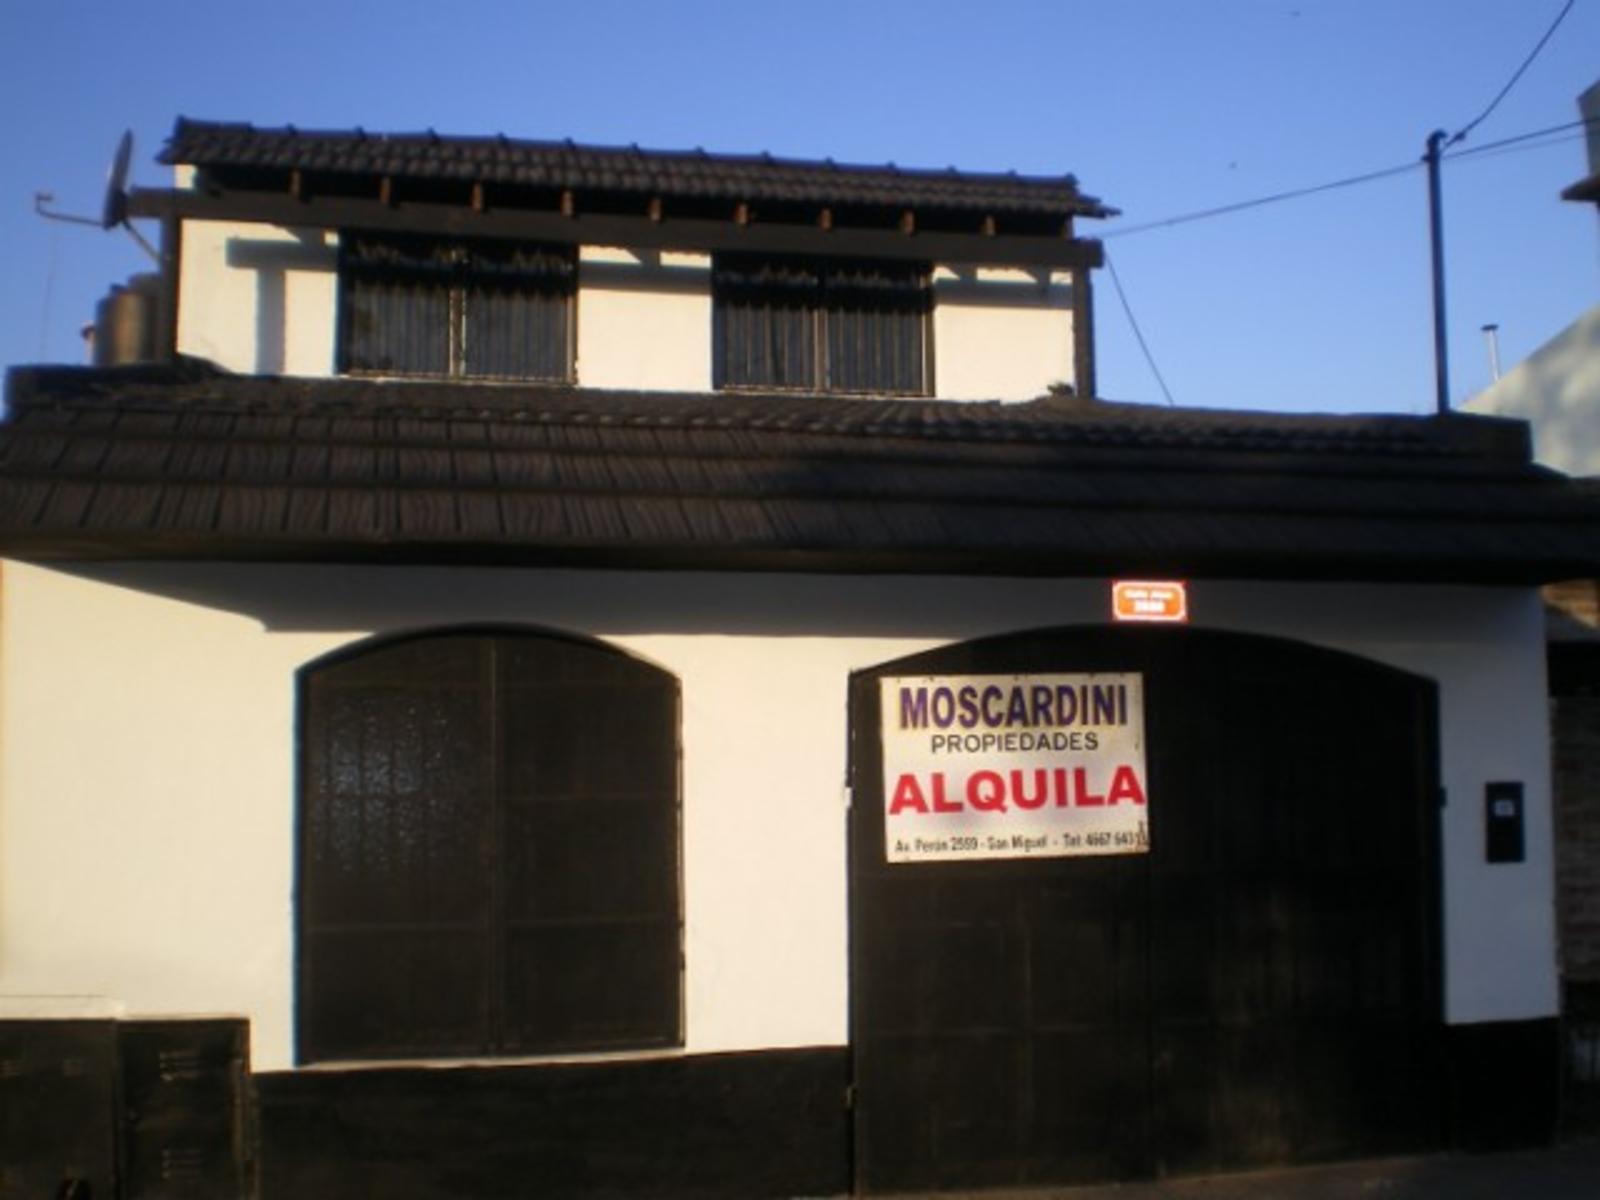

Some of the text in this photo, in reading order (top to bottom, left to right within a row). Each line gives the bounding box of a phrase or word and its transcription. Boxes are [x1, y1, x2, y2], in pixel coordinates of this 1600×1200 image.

[900, 685, 1128, 729] MOSCARDINI
[931, 732, 1099, 753] PROPIEDADES
[889, 765, 1146, 815] ALQUILA
